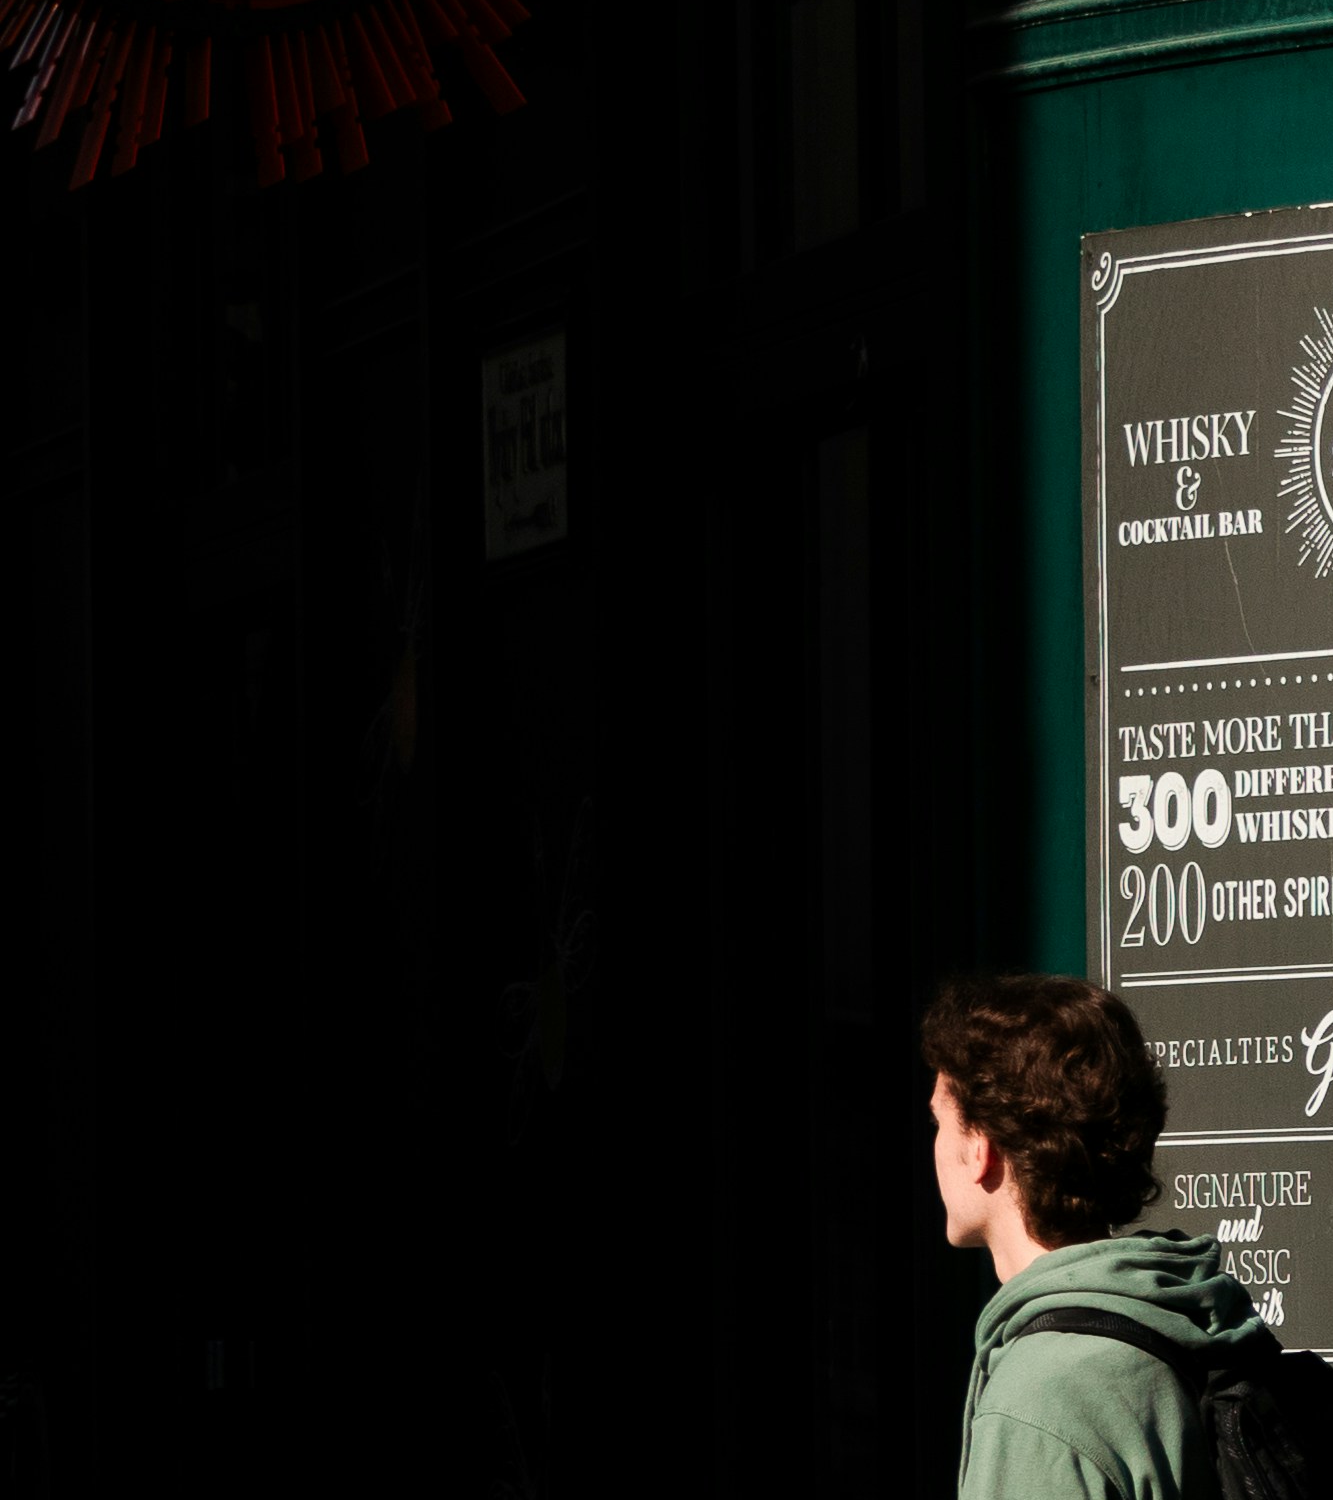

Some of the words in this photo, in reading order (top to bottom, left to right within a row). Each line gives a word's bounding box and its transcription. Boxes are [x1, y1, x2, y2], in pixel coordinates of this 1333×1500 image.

[1123, 410, 1257, 467] WHISKY
[1175, 465, 1201, 511] &
[1118, 513, 1215, 547] COCKTAIL
[1218, 508, 1264, 536] BAR
[1118, 721, 1196, 762] TASTE
[1202, 714, 1282, 756] MORE
[1118, 768, 1232, 855] 300
[1119, 861, 1207, 948] 200
[1211, 878, 1278, 922] OTHER
[1174, 1170, 1312, 1209] SIGNATURE
[1216, 1204, 1264, 1243] and
[1225, 1248, 1291, 1285] ASSIC
